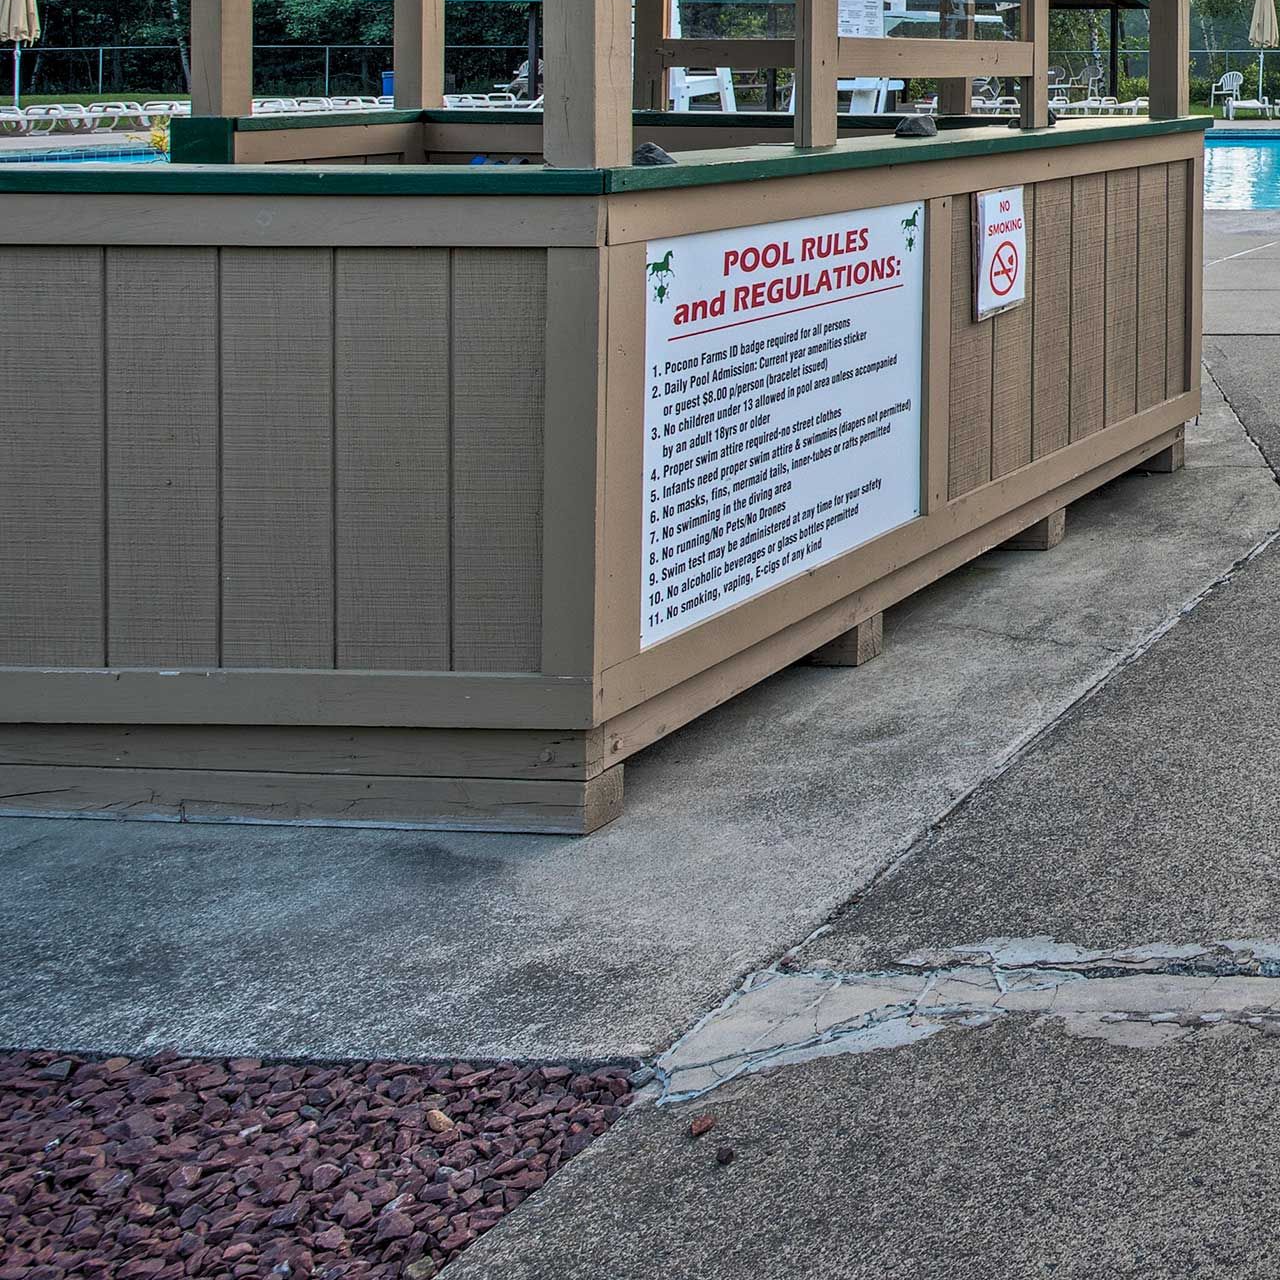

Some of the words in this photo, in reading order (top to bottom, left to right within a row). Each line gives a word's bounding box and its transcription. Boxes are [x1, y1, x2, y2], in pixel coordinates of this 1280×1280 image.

[988, 218, 1022, 237] SMOKING
[999, 200, 1010, 213] NO
[723, 241, 795, 277] POOL
[800, 227, 869, 262] RULES
[673, 289, 726, 326] and
[733, 255, 901, 313] REGULATIONS:
[651, 385, 662, 400] 2.
[664, 378, 688, 396] Daily
[689, 371, 710, 389] Pool
[711, 361, 758, 383] Admission:
[759, 350, 789, 370] Current
[789, 347, 806, 364] year
[807, 337, 843, 356] amenities
[843, 330, 868, 346] sticker
[652, 364, 662, 378] 1.
[664, 356, 699, 376] Pocono
[700, 349, 728, 366] Farms
[729, 344, 739, 359] ID
[740, 339, 765, 356] badge
[766, 328, 799, 349] required
[800, 327, 812, 340] for
[812, 322, 823, 337] all
[823, 318, 851, 337] persons
[650, 426, 661, 441] 3.
[663, 422, 676, 438] No
[678, 412, 715, 433] children
[717, 403, 742, 421] under
[743, 398, 754, 412] 13
[754, 387, 786, 409] allowed
[787, 386, 795, 399] in
[796, 379, 813, 399] pool
[813, 376, 831, 391] area
[831, 369, 854, 385] unless
[854, 353, 898, 377] accompanied
[663, 404, 674, 417] or
[675, 394, 701, 416] guest
[702, 386, 728, 407] $8.00
[729, 378, 765, 401] p/person
[765, 365, 801, 389] (bracelet
[802, 357, 829, 376] issued)
[650, 468, 661, 482] 4.
[662, 458, 694, 479] Proper
[695, 449, 719, 467] swim
[720, 441, 744, 459] attire
[745, 425, 791, 450] required-no
[791, 415, 815, 434] street
[815, 407, 842, 425] clothes
[650, 489, 660, 503] 5.
[662, 477, 696, 499] Infants
[697, 467, 719, 487] need
[720, 459, 748, 481] proper
[749, 450, 771, 468] swim
[771, 443, 794, 460] attire
[794, 438, 801, 451] &
[802, 427, 838, 449] swimmies
[838, 416, 867, 437] (diapers
[866, 410, 878, 425] not
[879, 398, 912, 423] permitted)
[662, 444, 674, 460] by
[675, 440, 688, 454] an
[689, 430, 713, 449] adult
[714, 424, 738, 441] 18yrs
[739, 421, 749, 433] or
[749, 413, 771, 429] older
[649, 509, 660, 524] 6.
[662, 504, 675, 520] No
[676, 493, 709, 515] masks,
[711, 486, 731, 501] fins,
[732, 468, 768, 493] mermaid
[769, 462, 790, 479] tails,
[791, 446, 833, 471] inner-tubes
[833, 443, 842, 455] or
[841, 436, 859, 451] rafts
[859, 421, 891, 447] permitted
[648, 572, 659, 587] 9.
[661, 562, 686, 582] Swim
[687, 551, 706, 570] test
[707, 545, 726, 562] may
[727, 540, 738, 553] be
[739, 514, 791, 548] administered
[792, 511, 801, 525] at
[801, 506, 816, 521] any
[816, 499, 833, 515] time
[833, 494, 845, 507] for
[845, 487, 861, 505] your
[860, 477, 883, 495] safety
[649, 530, 660, 545] 7.
[662, 525, 675, 541] No
[676, 508, 721, 535] swimming
[722, 503, 731, 517] in
[733, 498, 747, 512] the
[748, 487, 773, 506] diving
[774, 480, 792, 496] area
[649, 551, 659, 566] 8.
[661, 545, 674, 561] No
[676, 525, 724, 555] running/No
[725, 511, 758, 535] Pets/No
[759, 500, 787, 521] Drones
[648, 590, 664, 607] 10.
[666, 584, 679, 600] No
[681, 565, 723, 593] alcoholic
[723, 547, 766, 574] beverages
[767, 542, 777, 555] or
[777, 532, 798, 553] glass
[799, 520, 825, 540] bottles
[825, 503, 859, 531] permitted
[648, 611, 664, 628] 11.
[666, 604, 679, 620] No
[680, 587, 721, 614] smoking,
[723, 572, 754, 594] vaping,
[755, 559, 781, 579] E-cigs
[781, 551, 791, 567] of
[791, 547, 805, 562] any
[805, 536, 823, 555] kind
